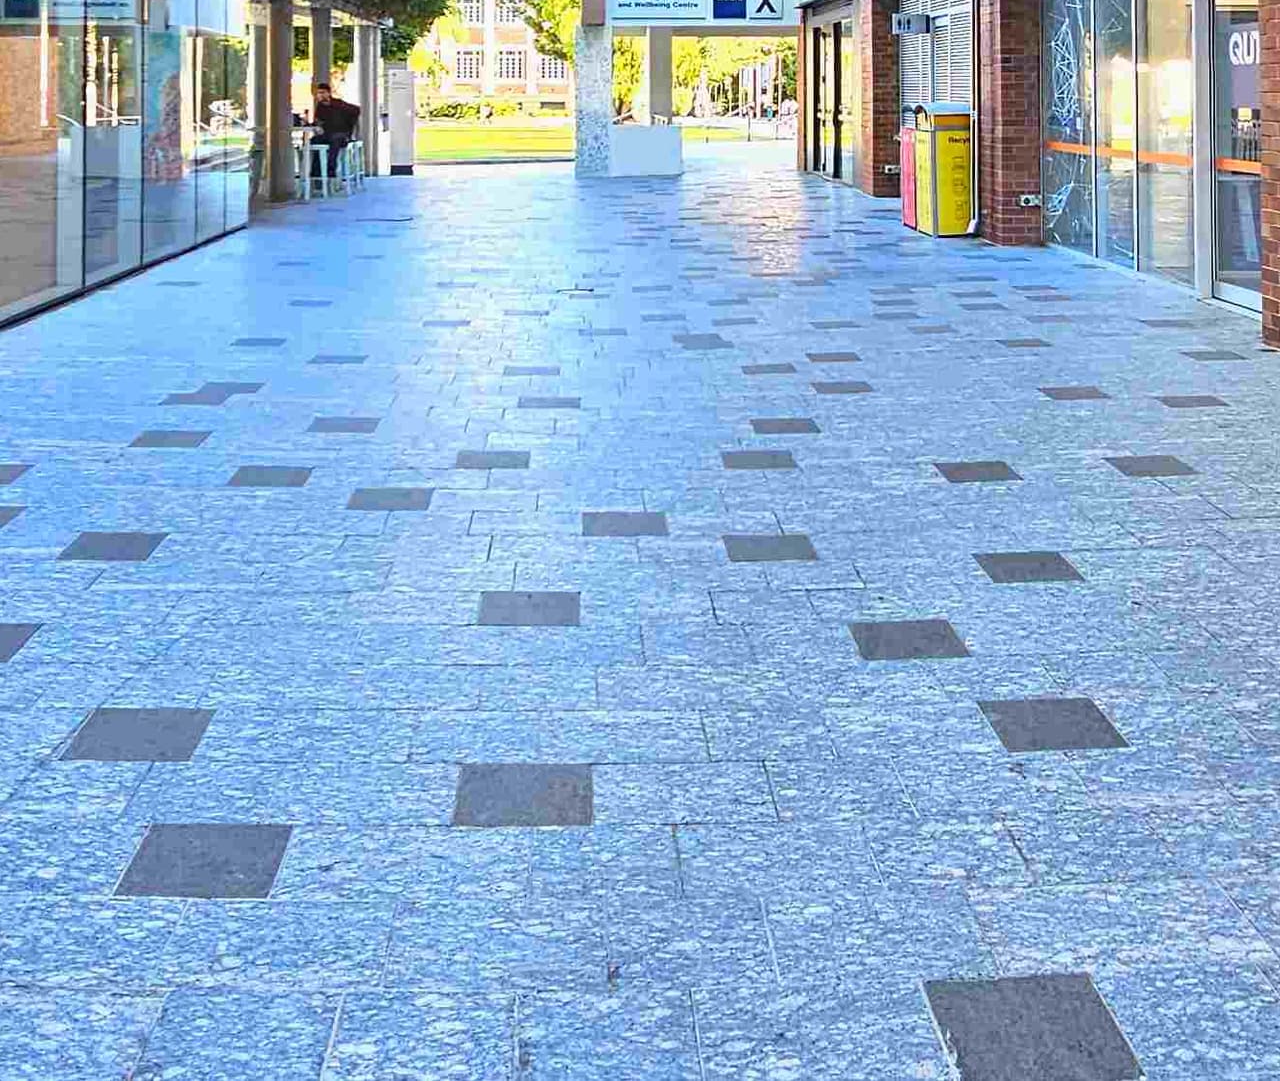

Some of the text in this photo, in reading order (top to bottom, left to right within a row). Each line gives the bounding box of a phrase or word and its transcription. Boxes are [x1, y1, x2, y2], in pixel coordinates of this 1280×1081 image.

[617, 1, 699, 10] and Wellbeing Centre
